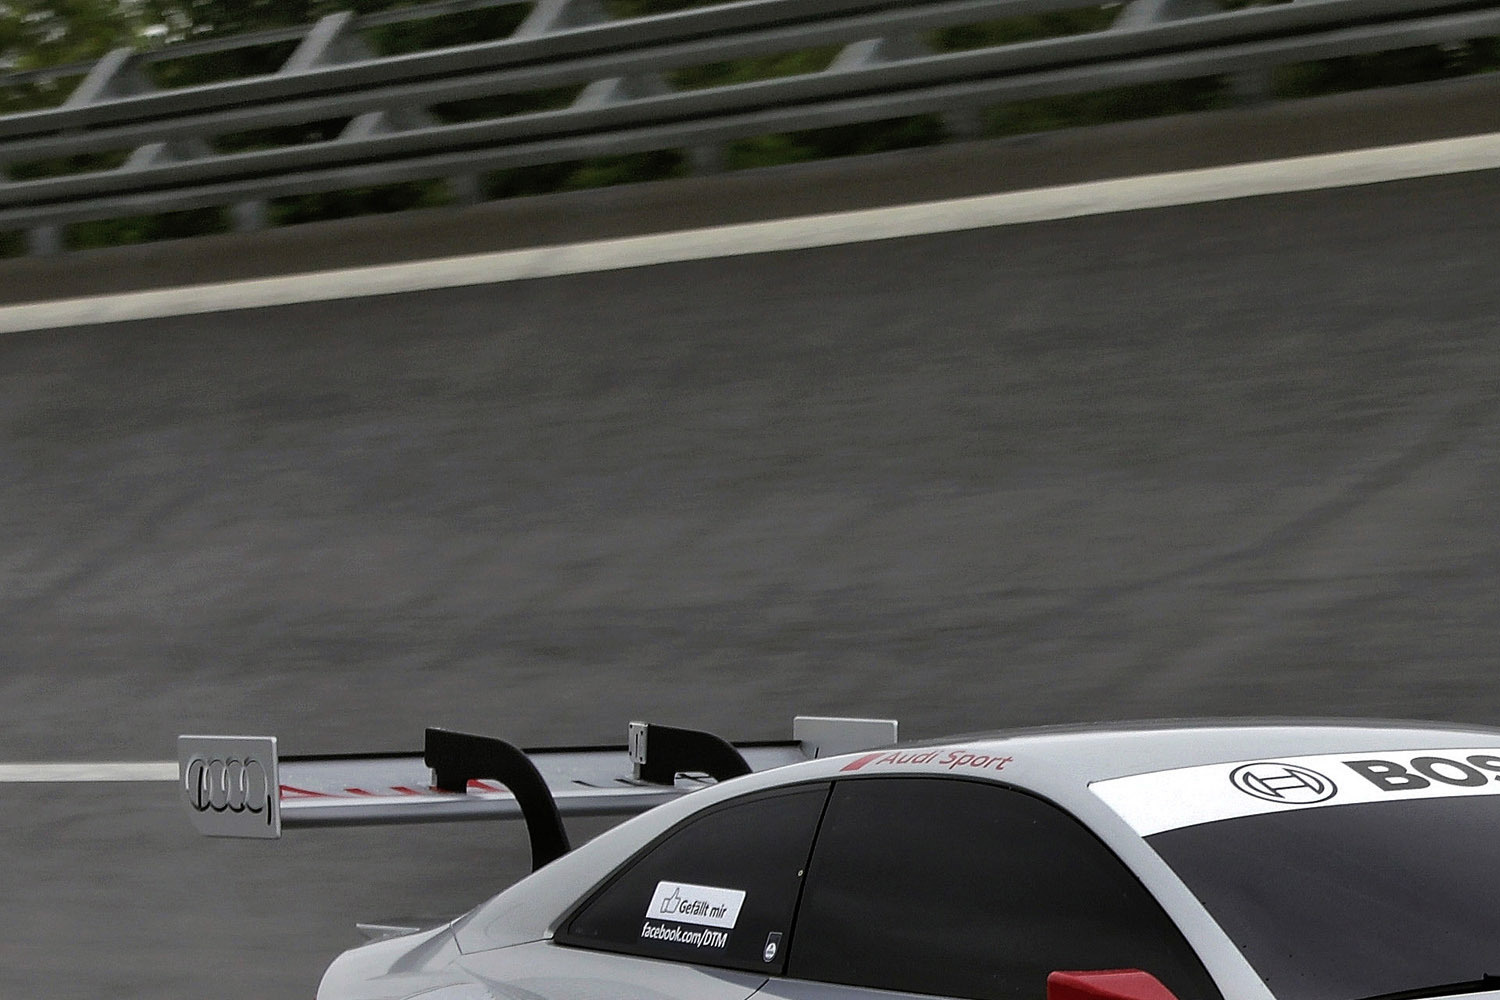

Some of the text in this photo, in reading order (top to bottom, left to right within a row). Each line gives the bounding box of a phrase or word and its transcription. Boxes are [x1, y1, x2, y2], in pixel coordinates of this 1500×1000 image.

[876, 750, 1014, 770] Audi Sport
[679, 899, 728, 918] Gefällt mir
[641, 921, 728, 949] facebook.com/DTM
